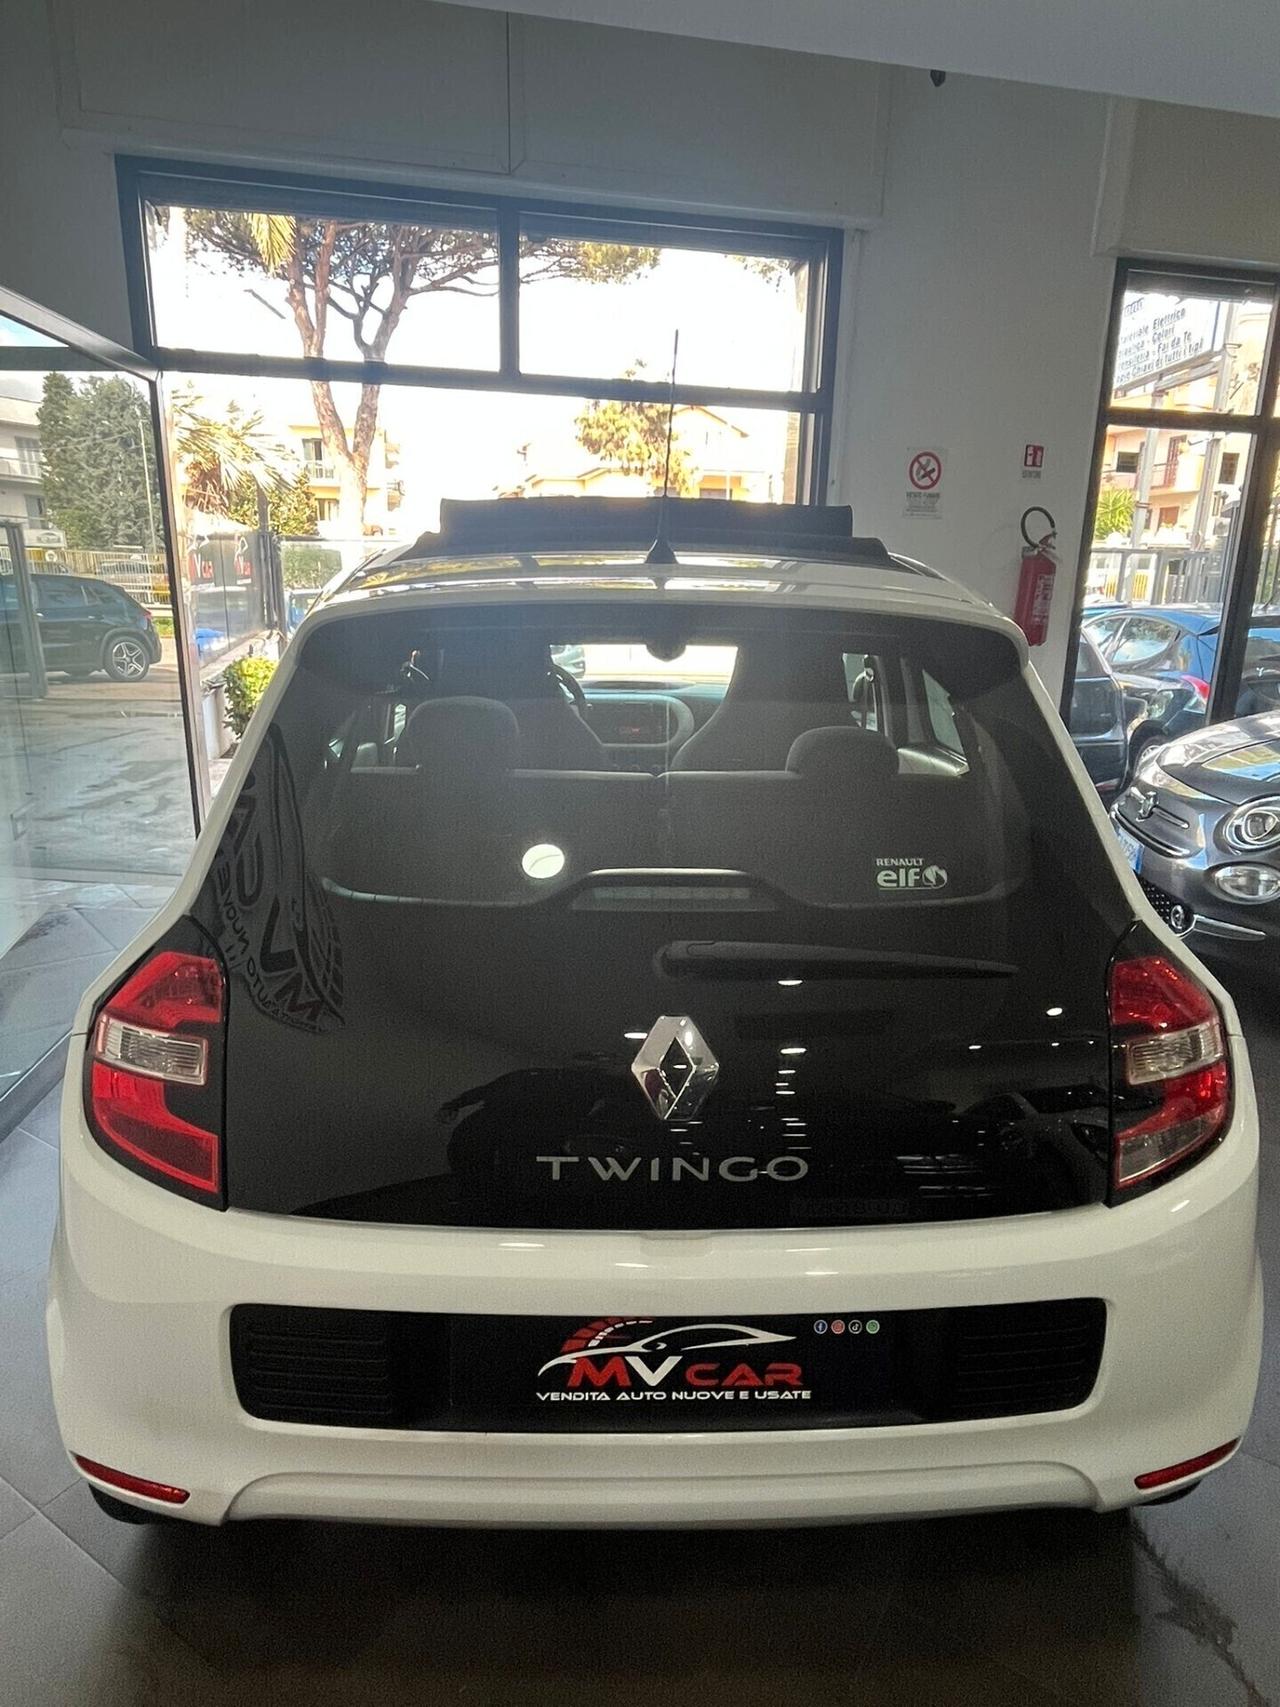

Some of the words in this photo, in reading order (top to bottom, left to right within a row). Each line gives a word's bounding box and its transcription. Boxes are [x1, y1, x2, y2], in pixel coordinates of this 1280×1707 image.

[876, 858, 924, 866] RENAULT
[876, 868, 920, 887] elf
[536, 1156, 809, 1182] TWINGO
[567, 1355, 683, 1388] MV
[685, 1363, 803, 1387] CAR
[536, 1391, 610, 1401] VENDITA
[616, 1391, 667, 1401] AUTO
[672, 1391, 735, 1400] NUOVE
[739, 1391, 750, 1399] E
[754, 1390, 811, 1400] USATE
